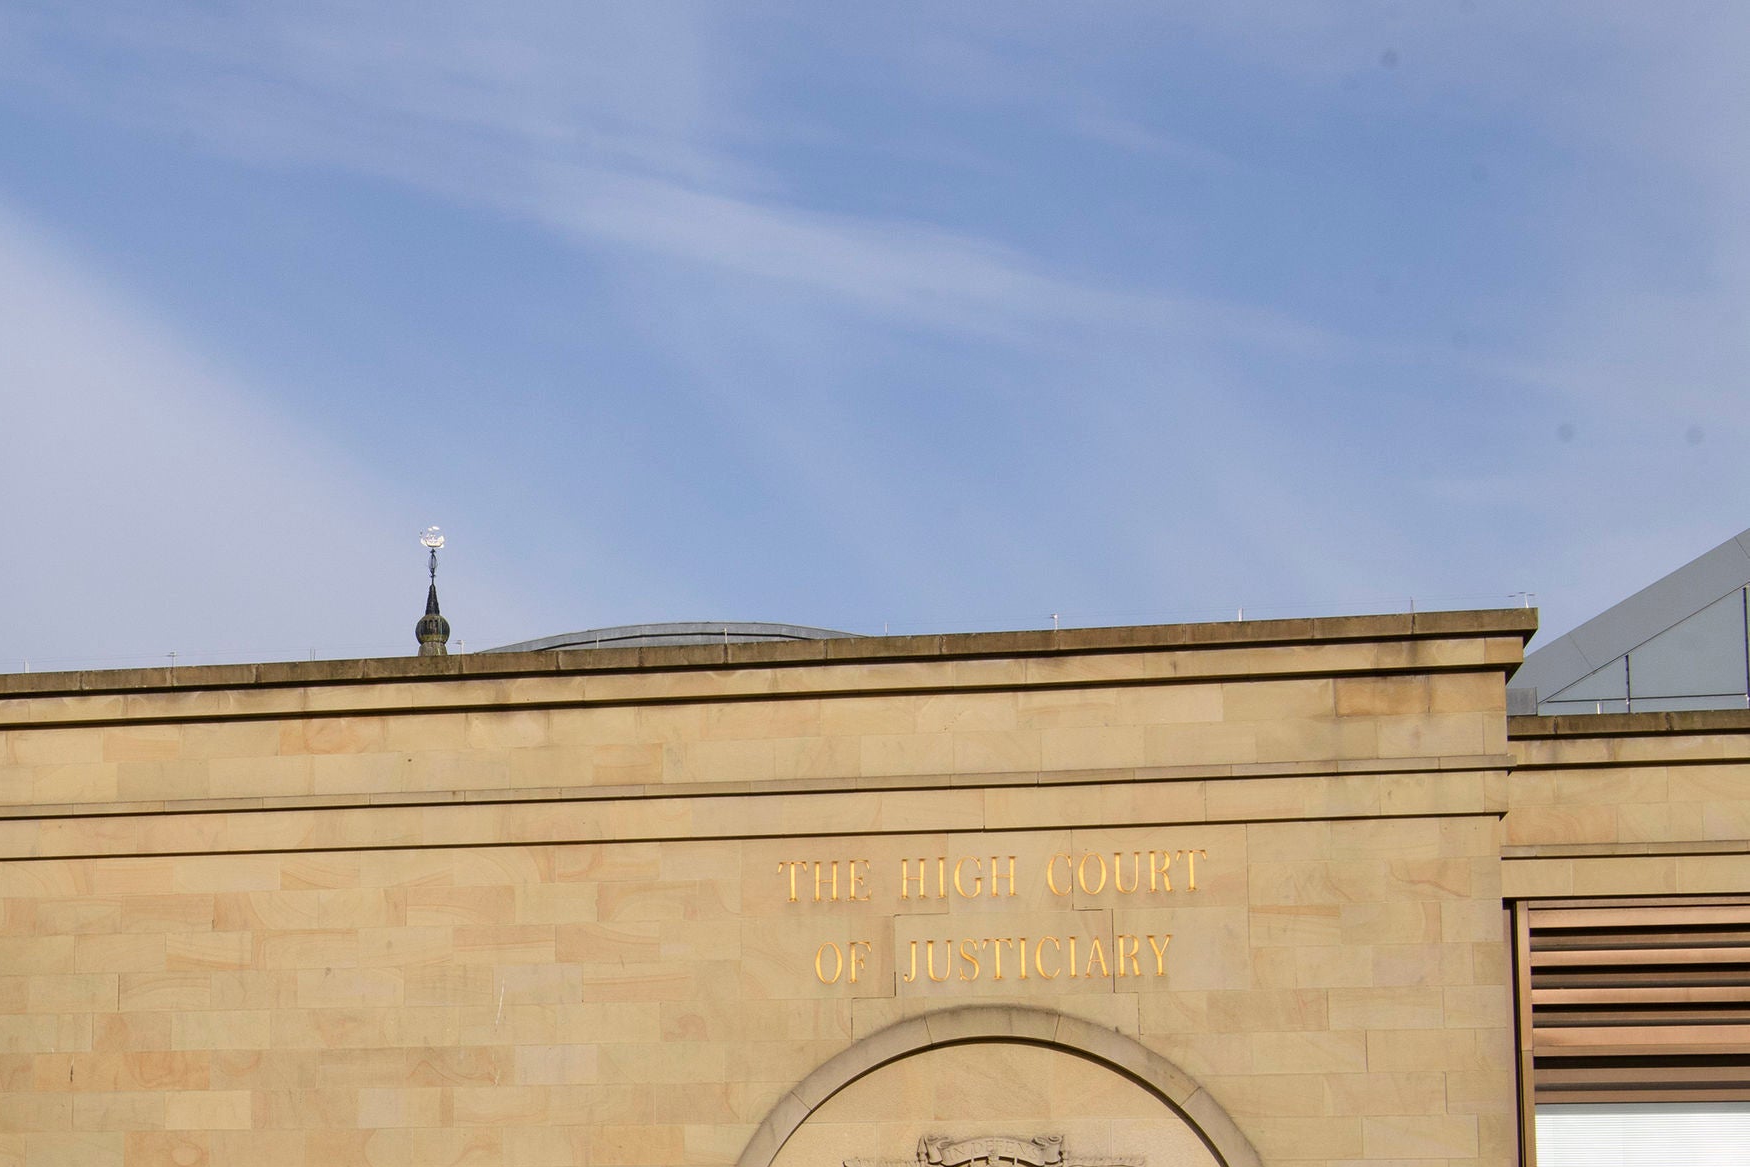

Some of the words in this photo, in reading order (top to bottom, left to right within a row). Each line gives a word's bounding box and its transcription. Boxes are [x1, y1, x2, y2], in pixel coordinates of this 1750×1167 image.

[777, 859, 873, 904] THE
[900, 855, 1018, 900] HIGH
[1045, 849, 1208, 897] COURT
[813, 940, 873, 985] OF
[902, 933, 1174, 983] JUSTICIARY
[945, 1147, 969, 1162] IN
[970, 1139, 1041, 1160] DEFENS
